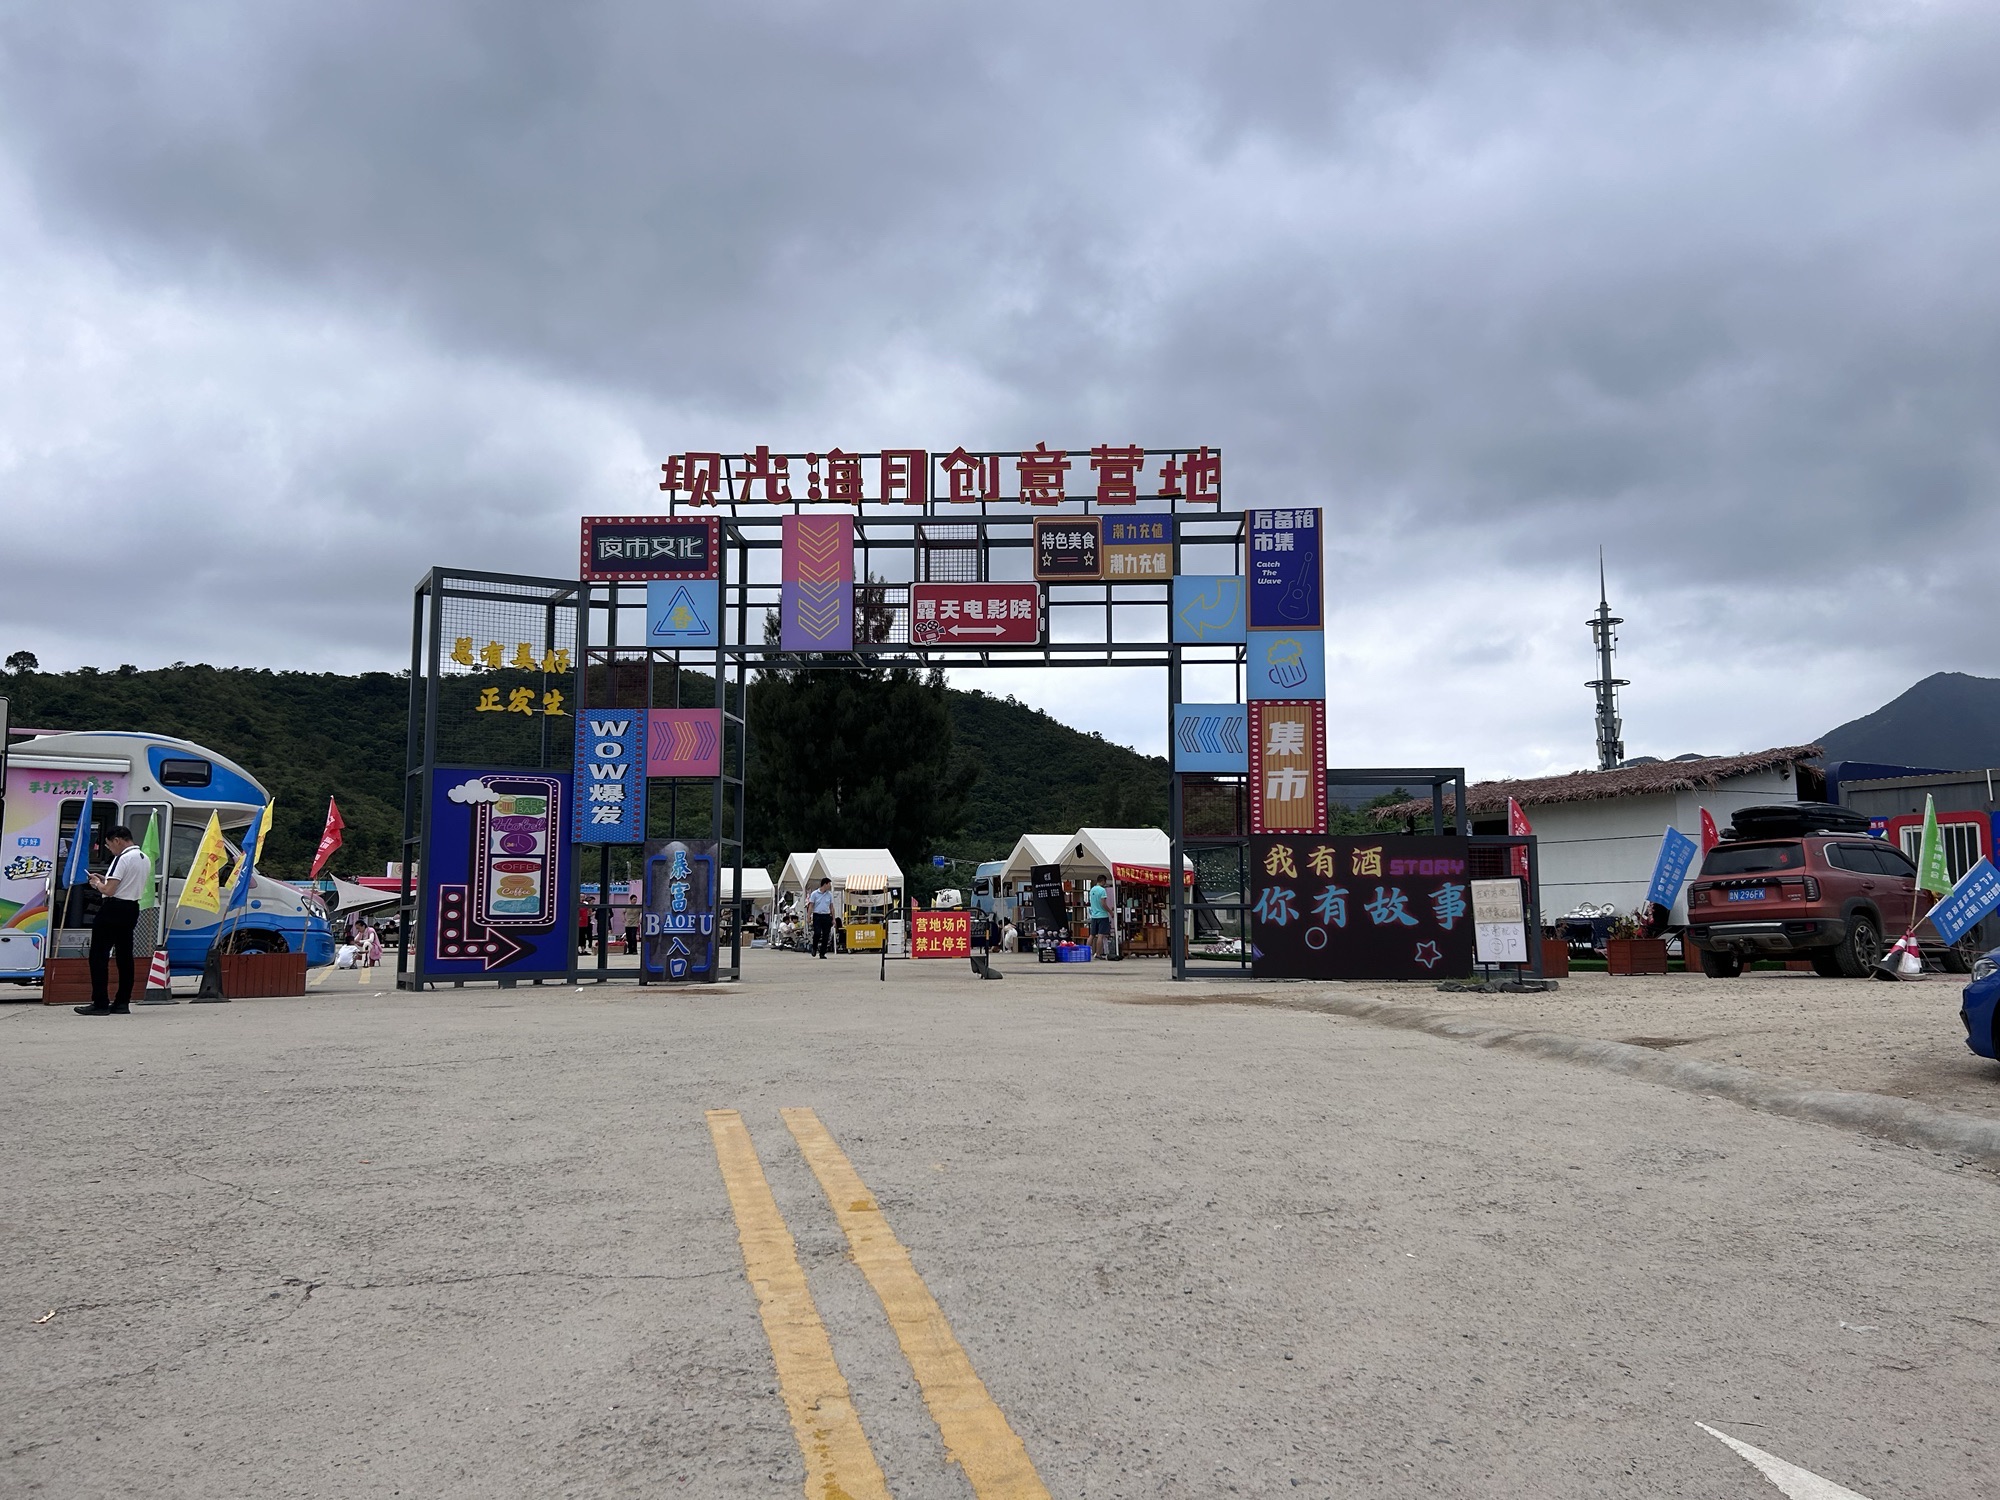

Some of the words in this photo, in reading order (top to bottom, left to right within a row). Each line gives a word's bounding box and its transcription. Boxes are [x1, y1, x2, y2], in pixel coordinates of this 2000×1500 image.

[660, 441, 1221, 507] 坝光海月创意营地
[1254, 509, 1314, 530] 后备箱
[1041, 531, 1095, 550] 特色美食
[1112, 523, 1164, 538] 潮力充值
[597, 536, 704, 560] 夜市文化
[1254, 532, 1294, 552] 市集
[1109, 553, 1167, 574] 潮力充值
[916, 599, 1032, 620] 露天电影院
[451, 636, 571, 674] 总有美好
[475, 686, 564, 716] 正发生
[1265, 720, 1309, 802] 集市
[52, 787, 81, 795] Lemon
[83, 788, 99, 796] ta
[516, 806, 539, 814] BAR
[1263, 844, 1383, 878] 我有酒
[1389, 859, 1465, 876] STORY
[501, 887, 532, 896] Coffee
[669, 850, 692, 913] 暴富
[1720, 878, 1767, 886] HAVAL
[1252, 881, 1467, 930] 你有故事
[645, 913, 714, 936] BAOFU
[916, 917, 967, 932] 营地场内
[916, 937, 967, 952] 禁止停车
[667, 936, 691, 978] 入口
